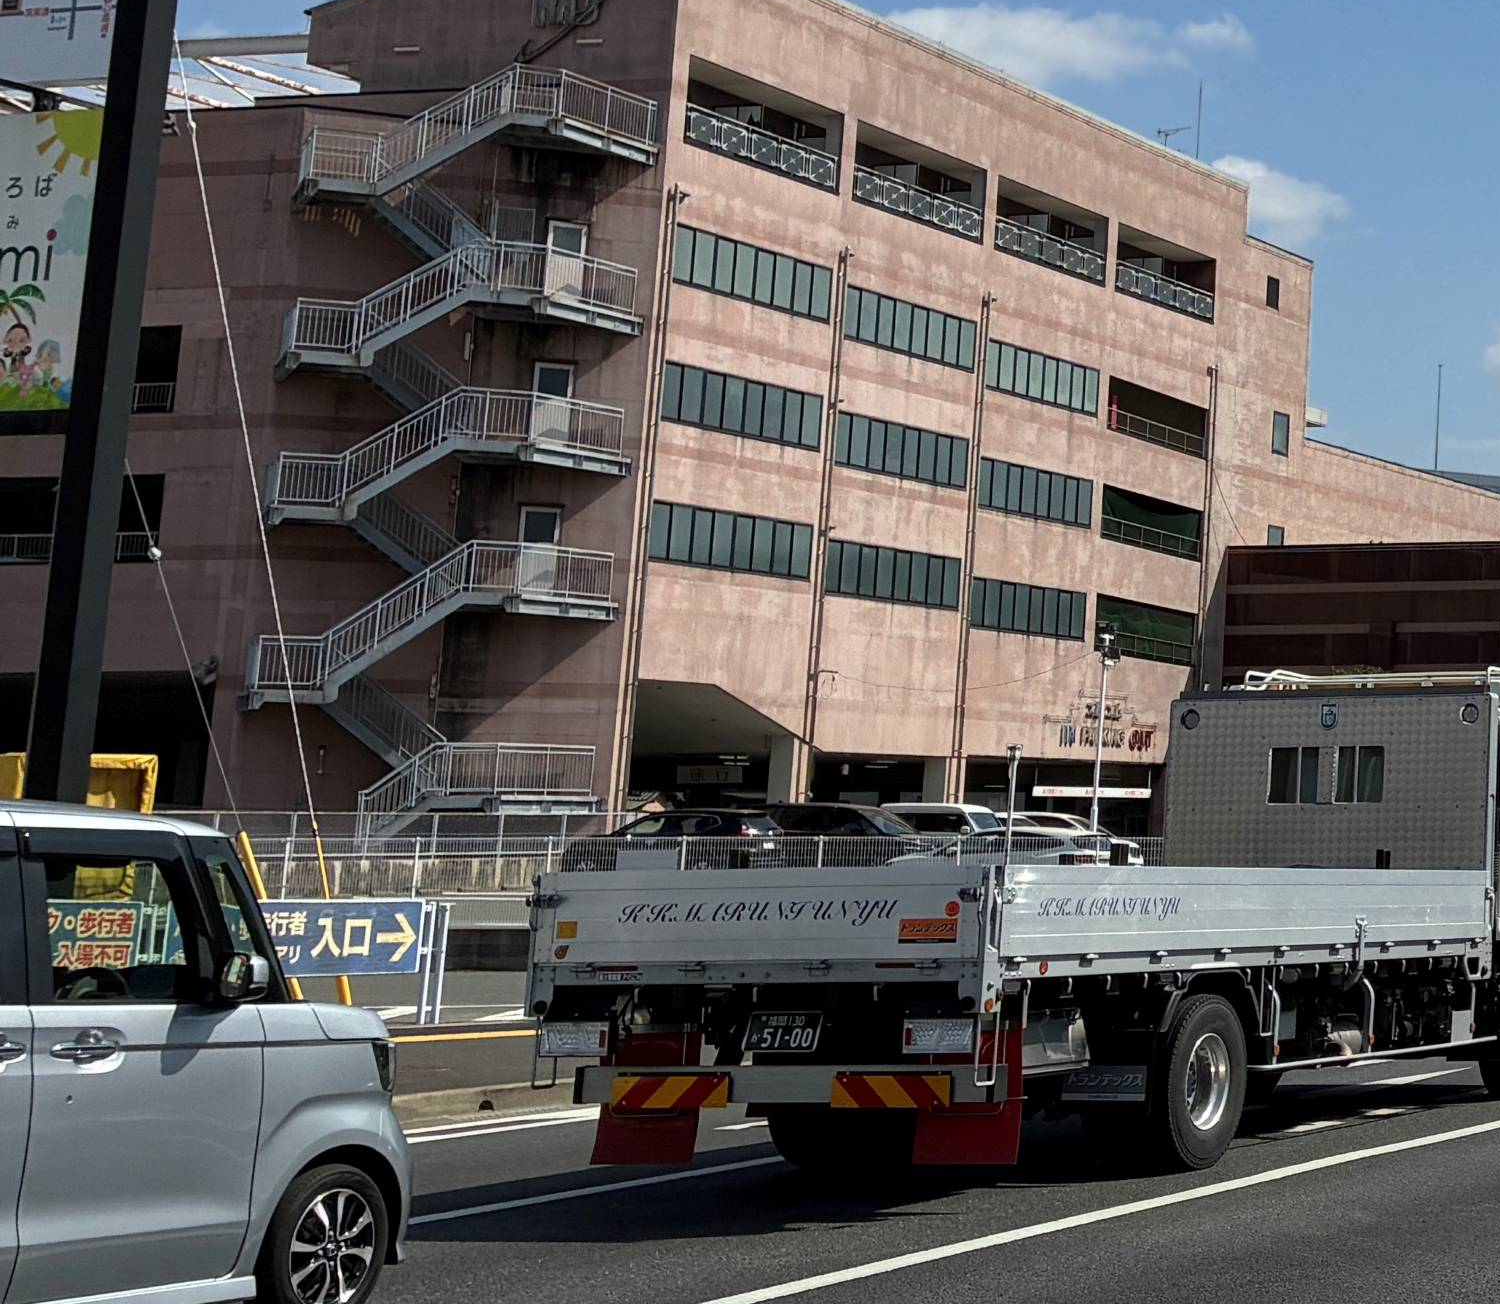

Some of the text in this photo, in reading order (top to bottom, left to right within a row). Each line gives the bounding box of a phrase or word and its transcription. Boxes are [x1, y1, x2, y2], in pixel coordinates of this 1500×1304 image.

[310, 917, 373, 958] 入口
[56, 942, 133, 967] 入場不可
[760, 1027, 814, 1048] 51-00
